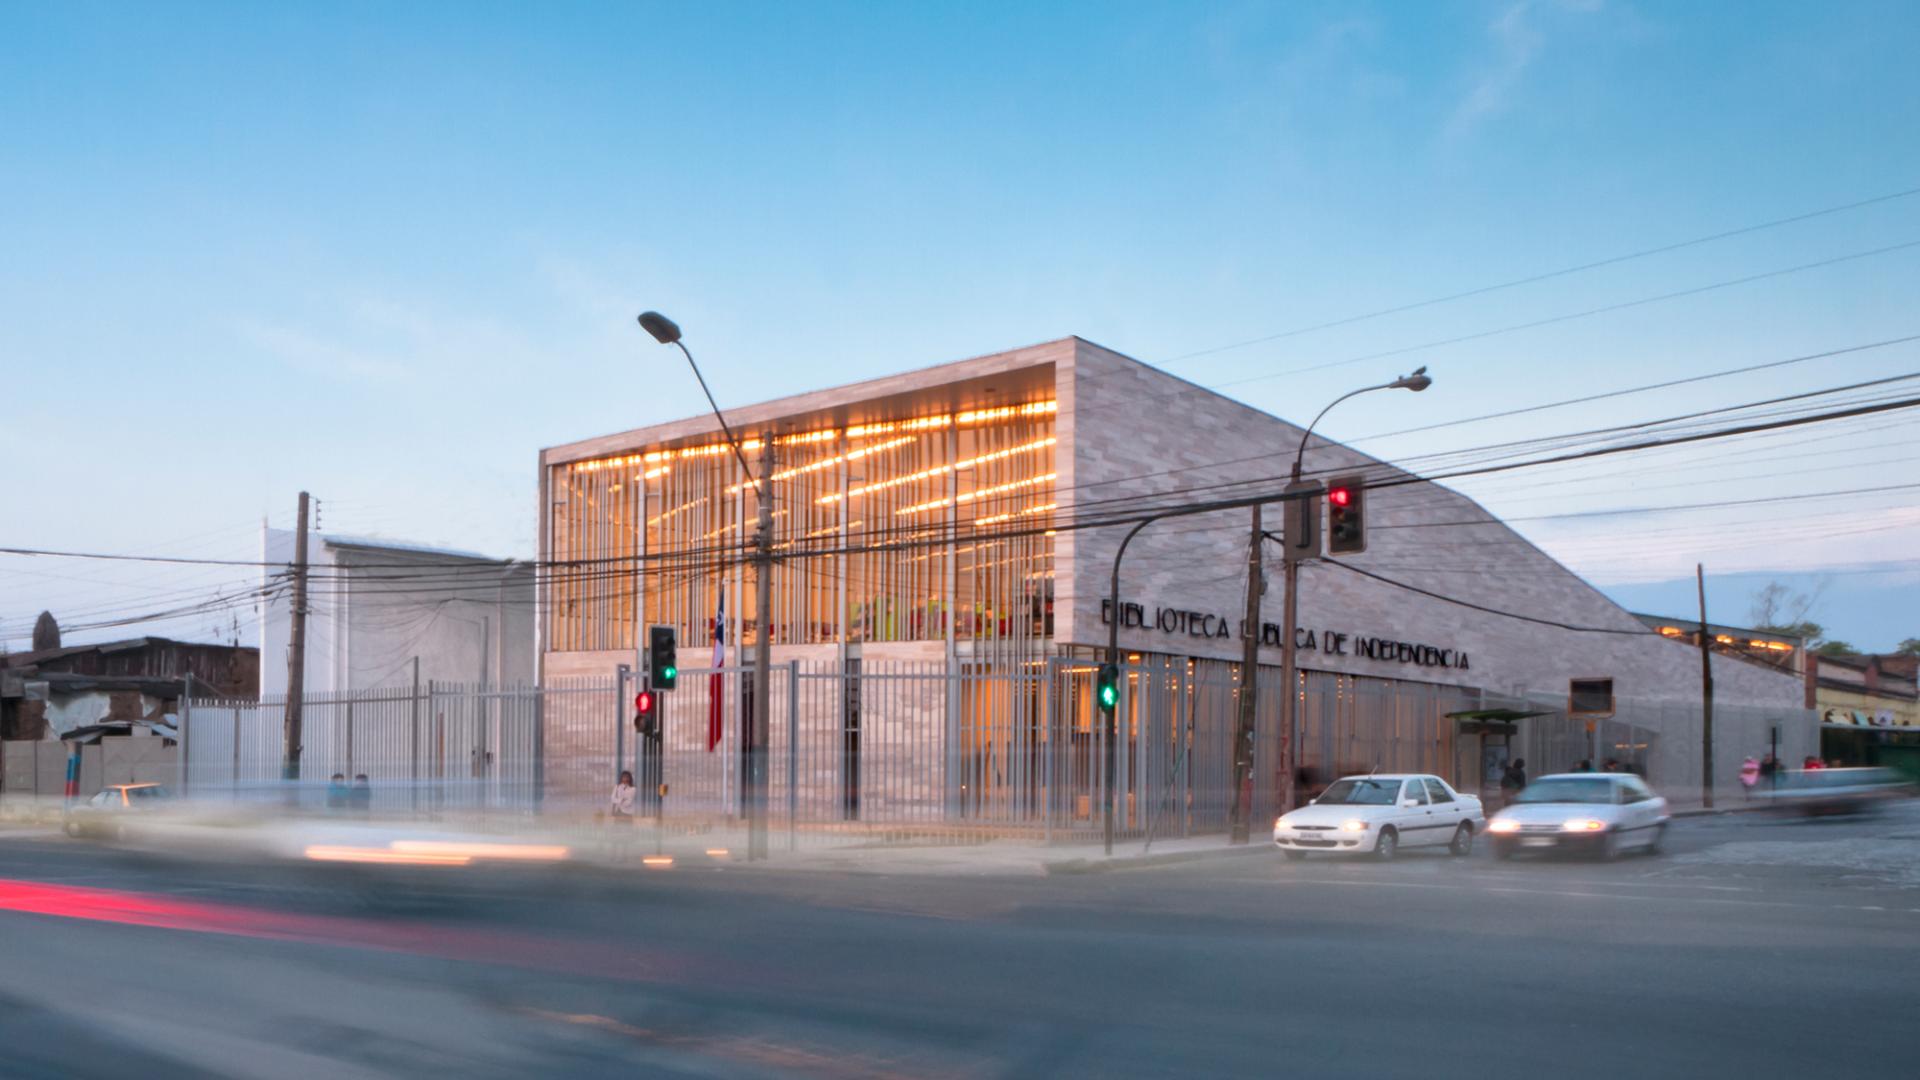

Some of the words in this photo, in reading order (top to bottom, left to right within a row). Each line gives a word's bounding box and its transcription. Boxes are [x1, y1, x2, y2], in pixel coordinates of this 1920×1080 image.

[1102, 599, 1230, 639] BIBLIOTECA
[1325, 630, 1347, 655] DE
[1355, 636, 1469, 670] INDEPENDENCIA
